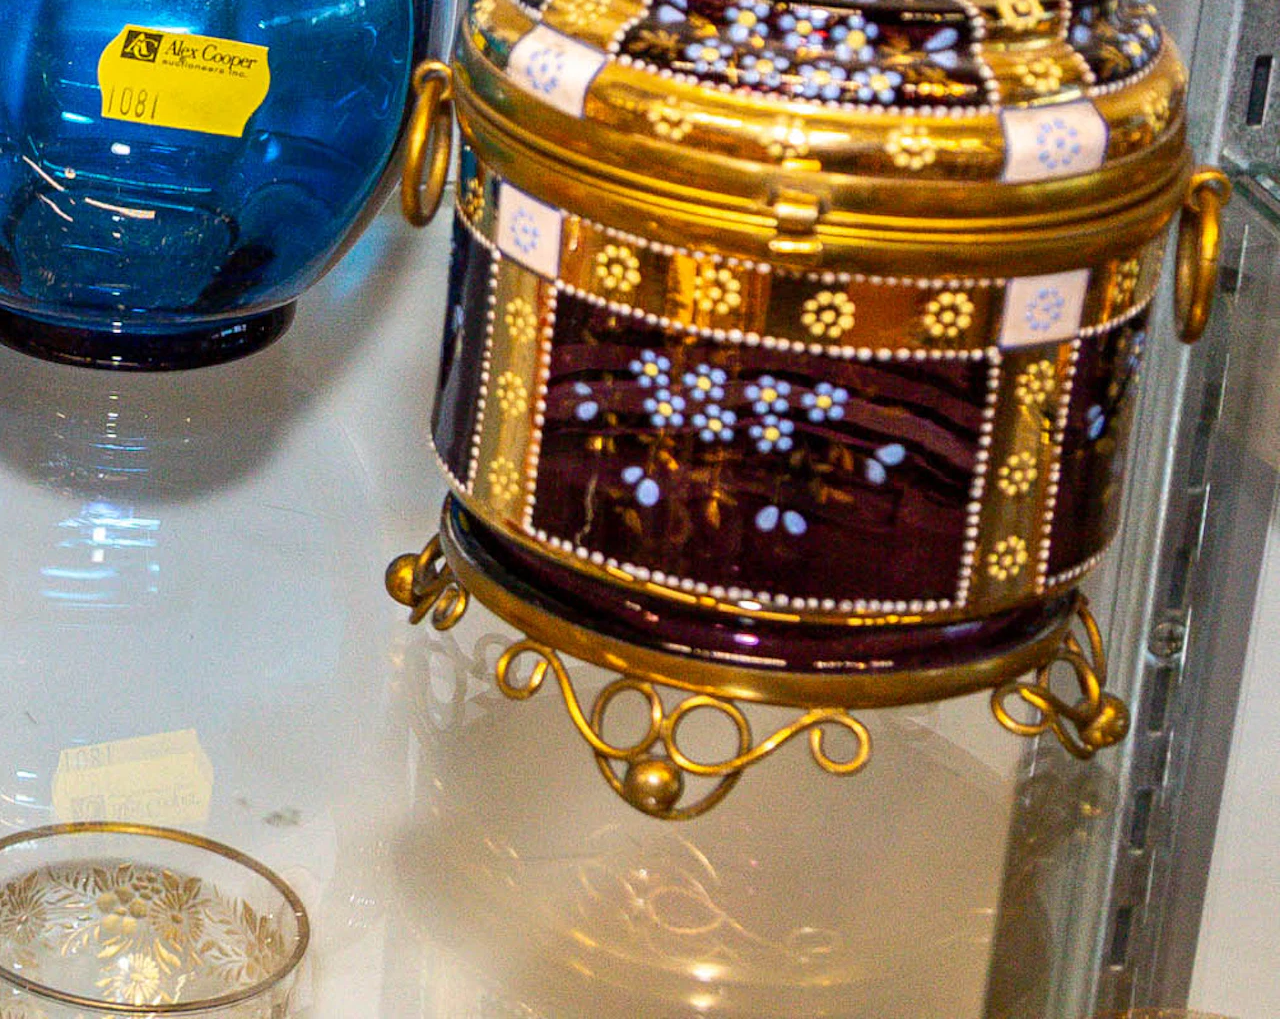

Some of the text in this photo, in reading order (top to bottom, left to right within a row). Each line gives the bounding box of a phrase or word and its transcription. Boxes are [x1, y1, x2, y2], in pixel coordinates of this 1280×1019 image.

[162, 59, 225, 74] auctioneers
[164, 39, 259, 70] Alex Cooper
[107, 86, 160, 120] 1081
